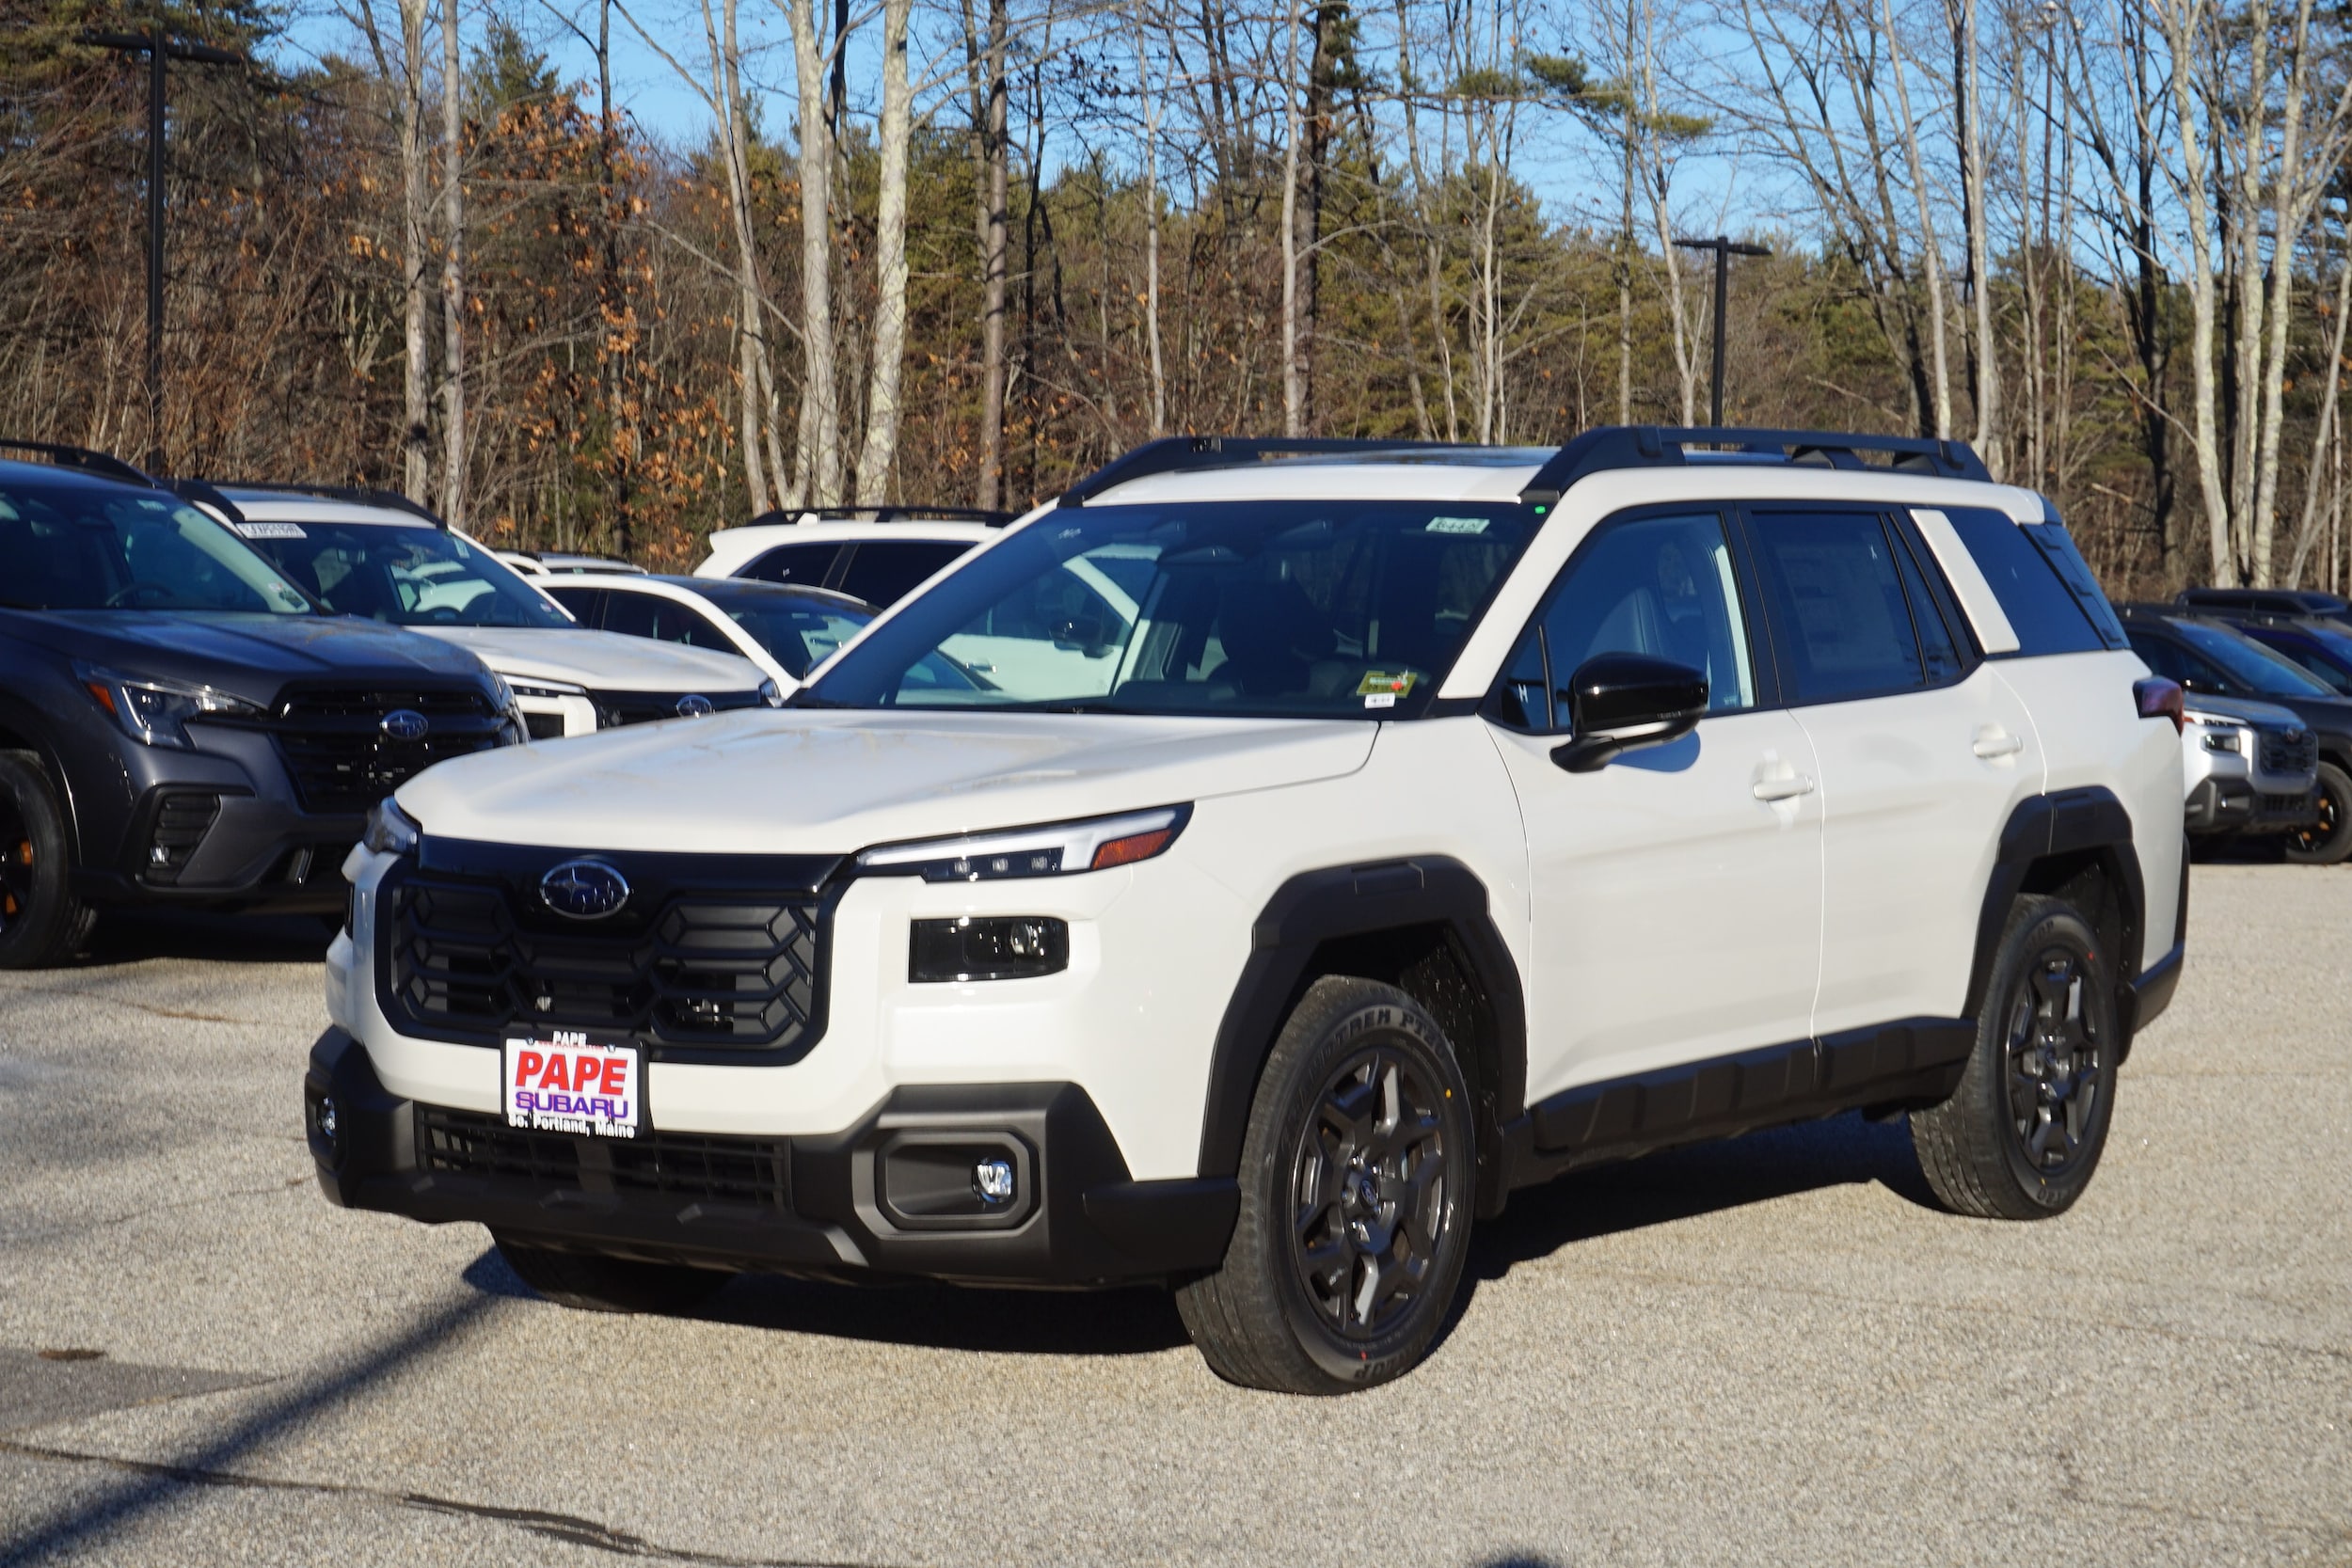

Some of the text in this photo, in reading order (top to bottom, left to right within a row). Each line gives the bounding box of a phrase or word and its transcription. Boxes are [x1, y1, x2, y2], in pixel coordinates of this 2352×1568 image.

[553, 1031, 587, 1046] PAPE
[516, 1051, 628, 1096] PAPE
[516, 1091, 628, 1118] SUBARU
[532, 1114, 590, 1137] Portland,
[595, 1120, 636, 1138] Maine
